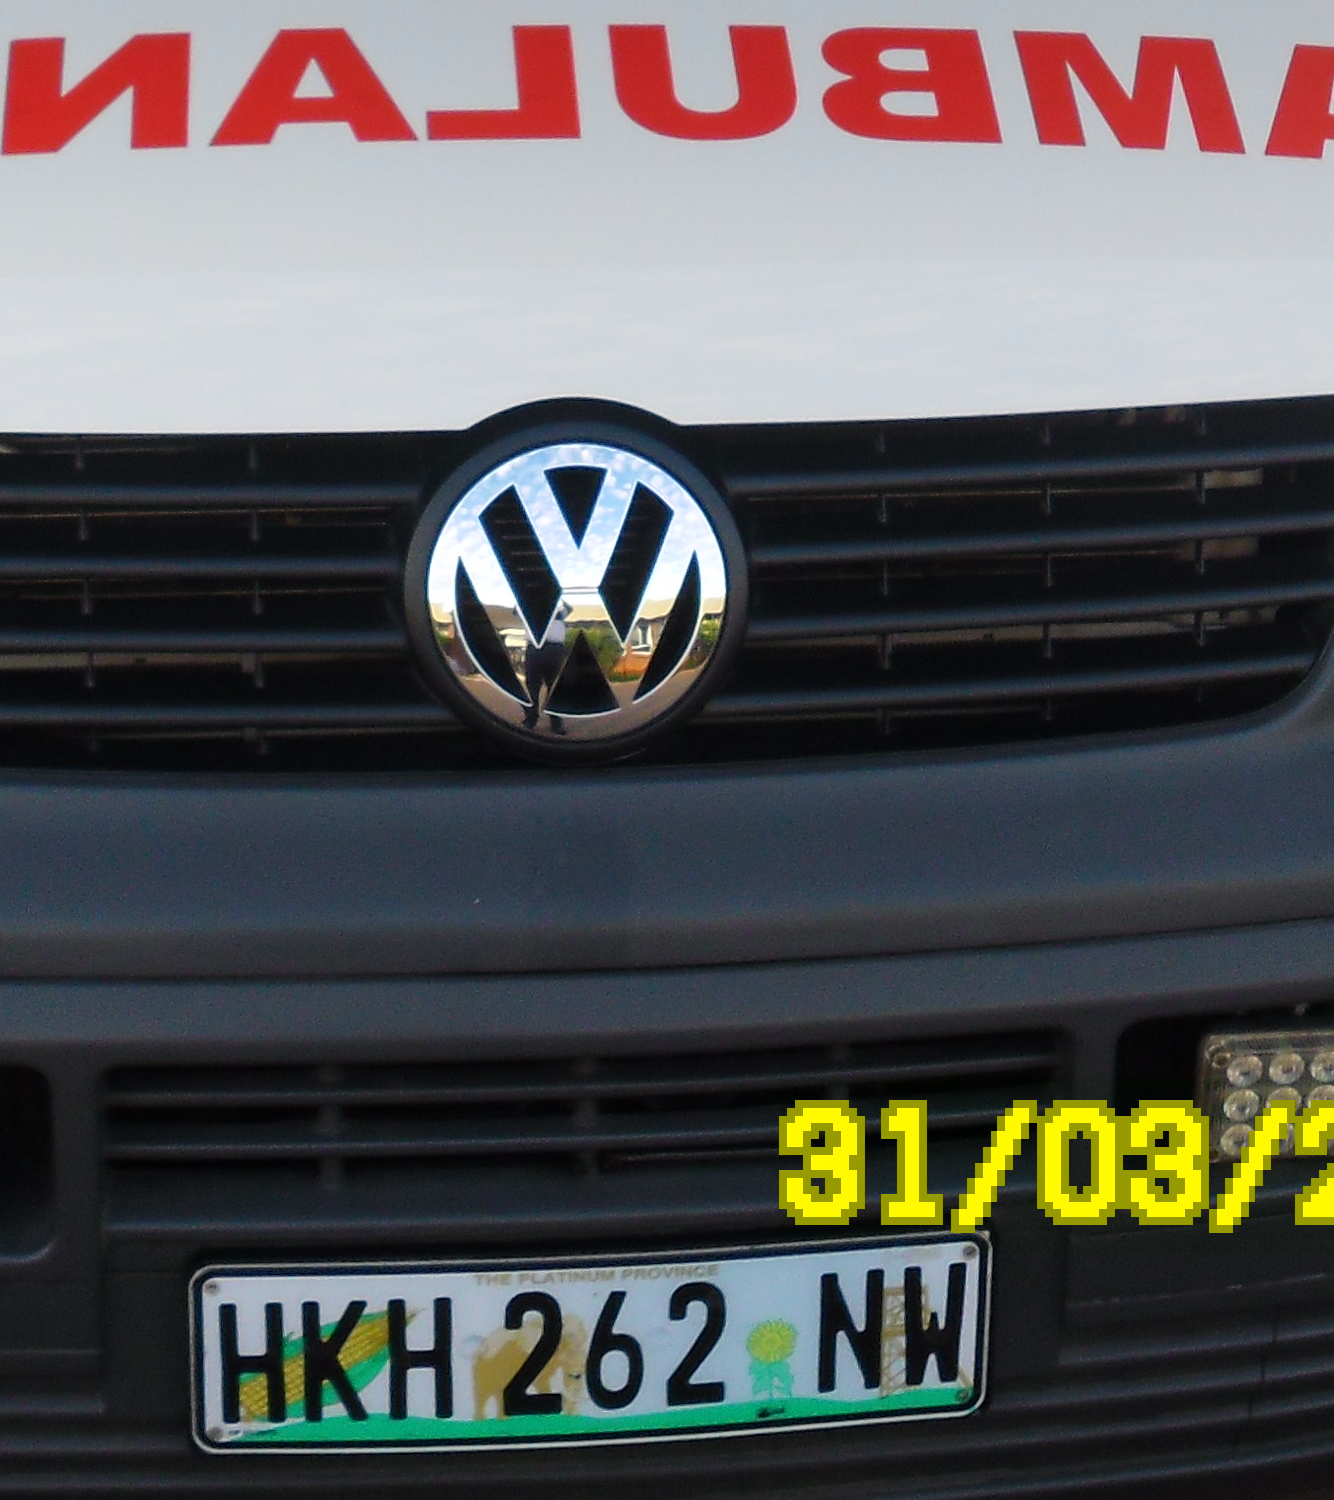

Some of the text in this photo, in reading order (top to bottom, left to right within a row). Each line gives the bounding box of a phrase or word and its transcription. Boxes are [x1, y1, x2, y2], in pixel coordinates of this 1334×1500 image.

[476, 1264, 720, 1286] THE PLATINUM PROVINCE
[217, 1262, 970, 1425] HKH 262 NW
